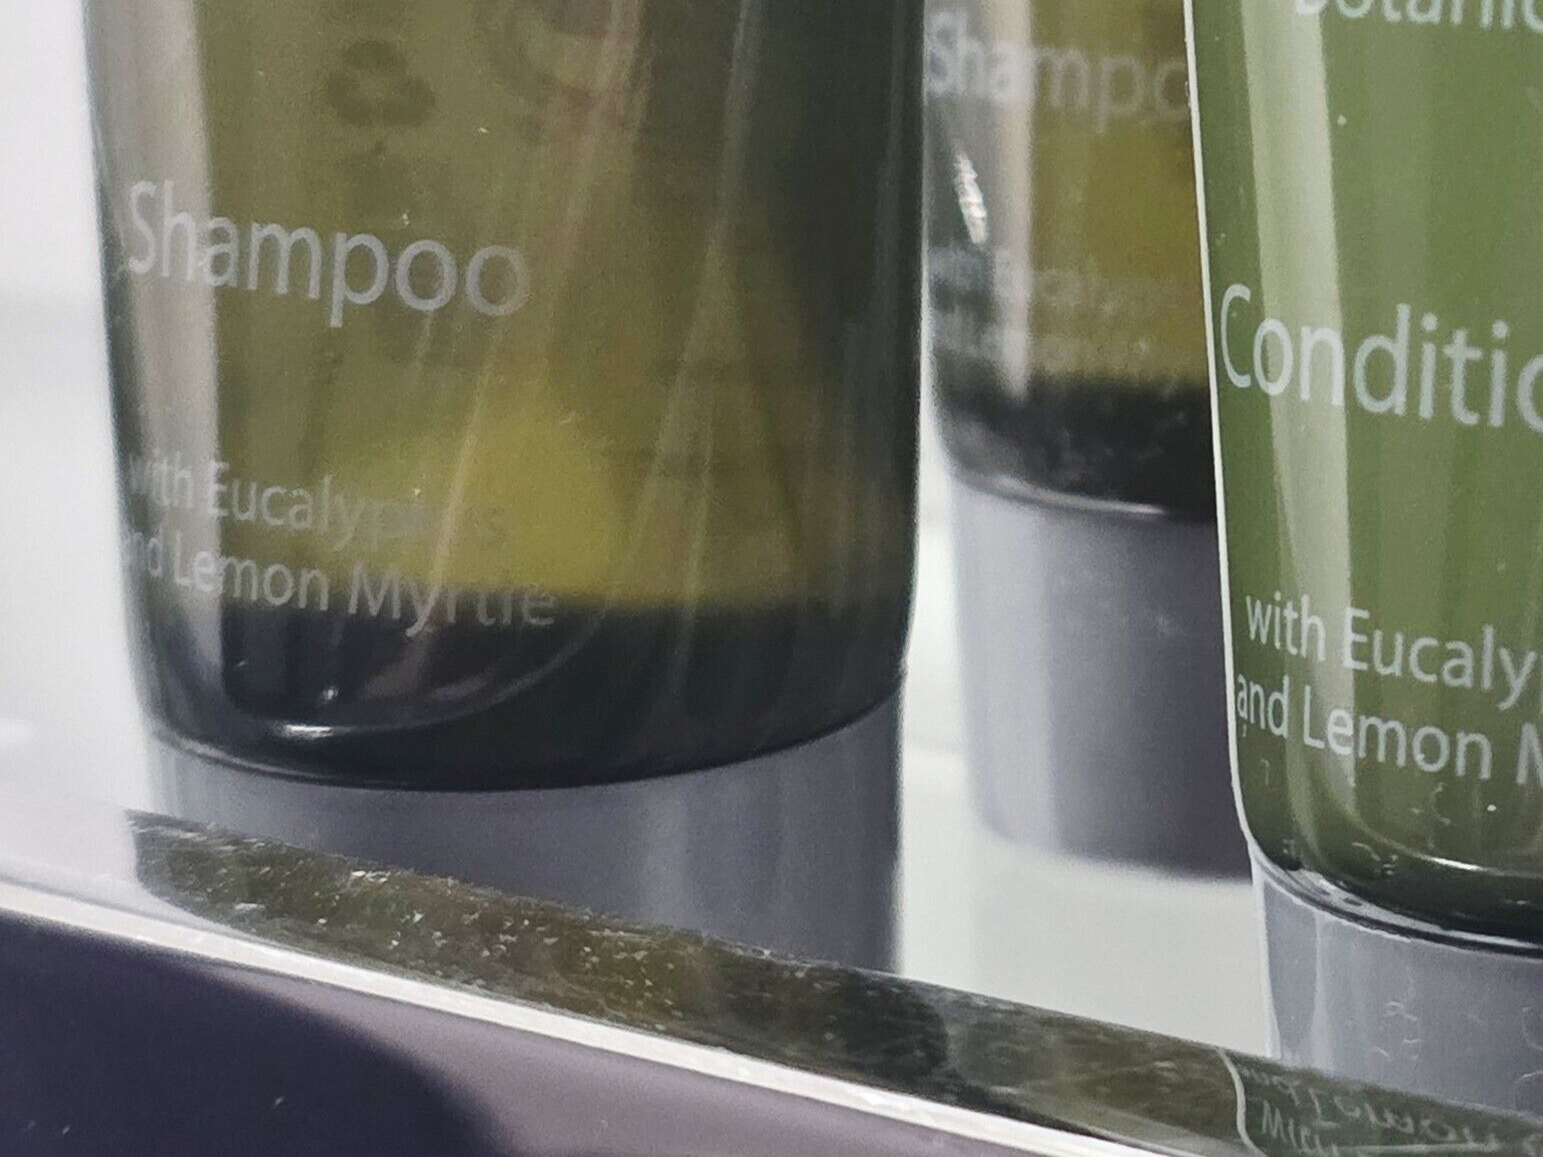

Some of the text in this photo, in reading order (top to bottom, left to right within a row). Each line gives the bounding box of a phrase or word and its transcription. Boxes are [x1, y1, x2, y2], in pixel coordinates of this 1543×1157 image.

[126, 180, 531, 328] Shampoo
[174, 530, 329, 611] Lemon
[1246, 591, 1327, 663] with
[1237, 673, 1290, 739] and
[1303, 685, 1492, 780] Lemon
